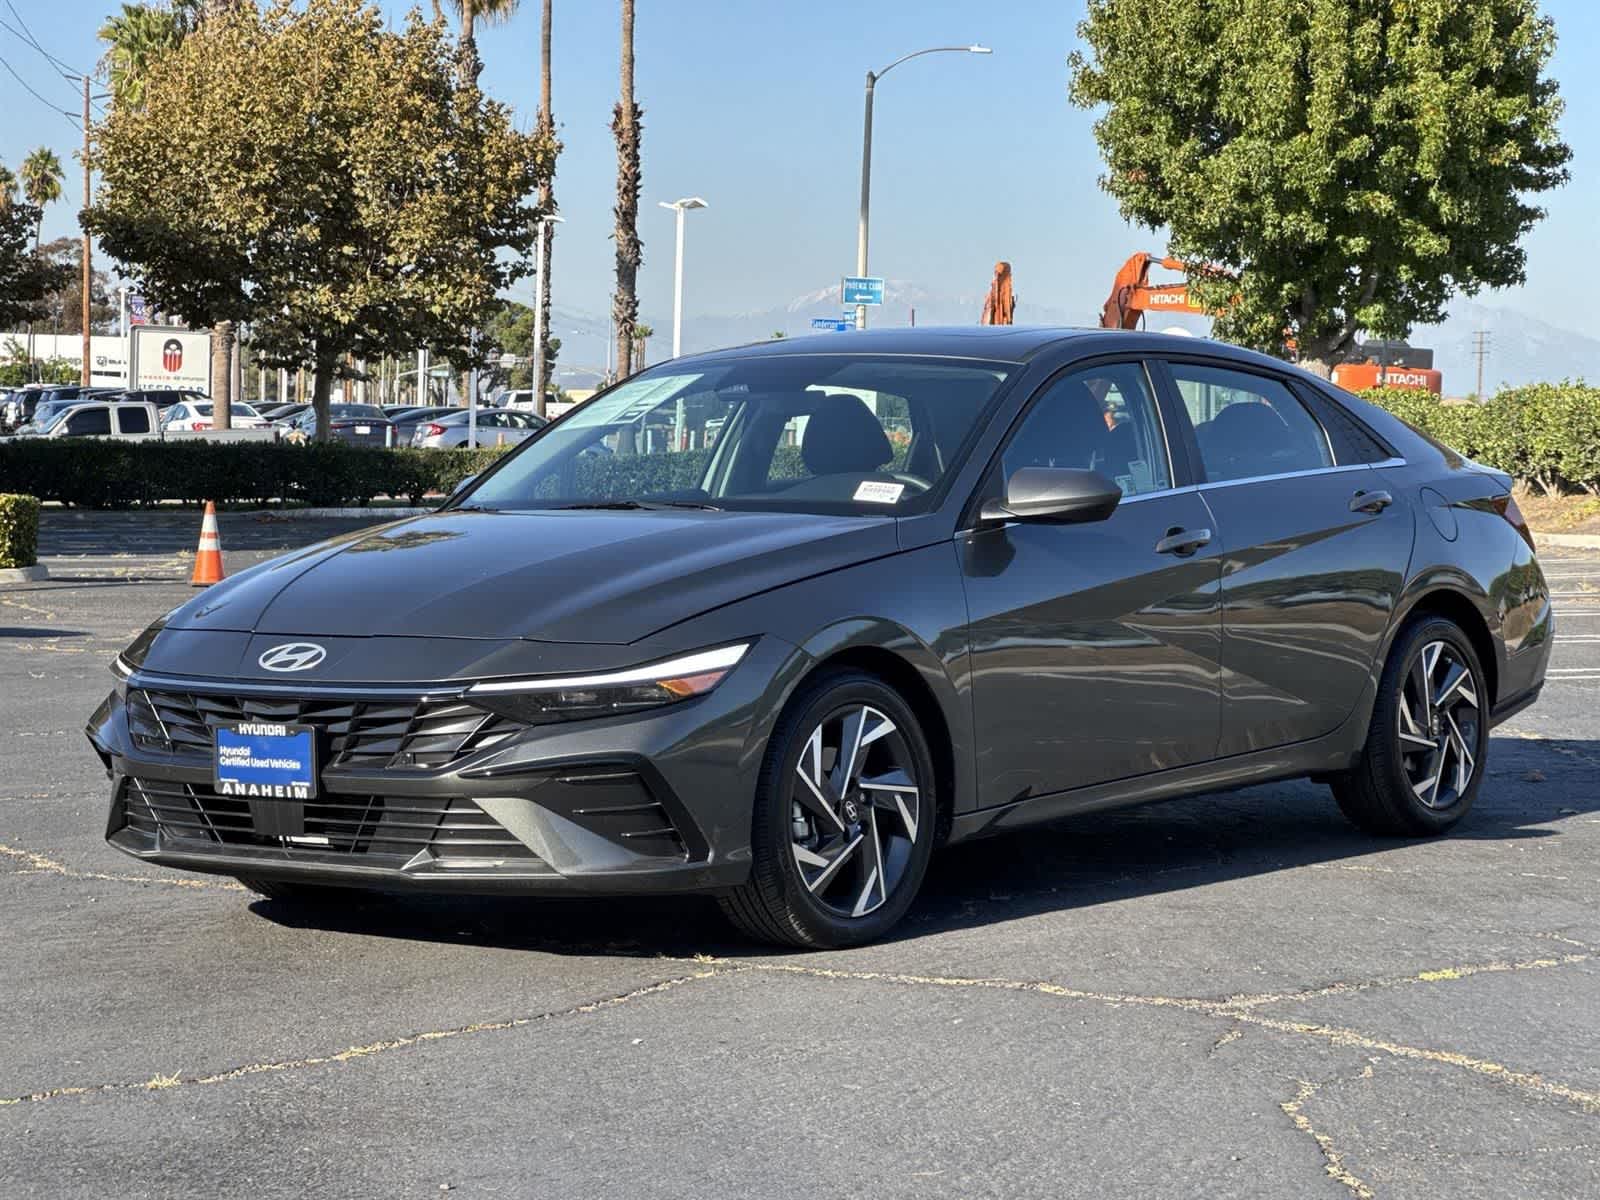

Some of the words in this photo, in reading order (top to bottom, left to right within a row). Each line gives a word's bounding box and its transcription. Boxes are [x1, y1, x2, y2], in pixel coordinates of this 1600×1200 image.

[1150, 294, 1185, 304] HITACHI
[238, 723, 286, 736] HYUNDAI
[220, 745, 251, 756] Hyundai
[220, 756, 250, 768] Certified
[251, 758, 269, 768] Used
[270, 759, 301, 770] Vehicles
[222, 783, 308, 798] ANAHEIM
